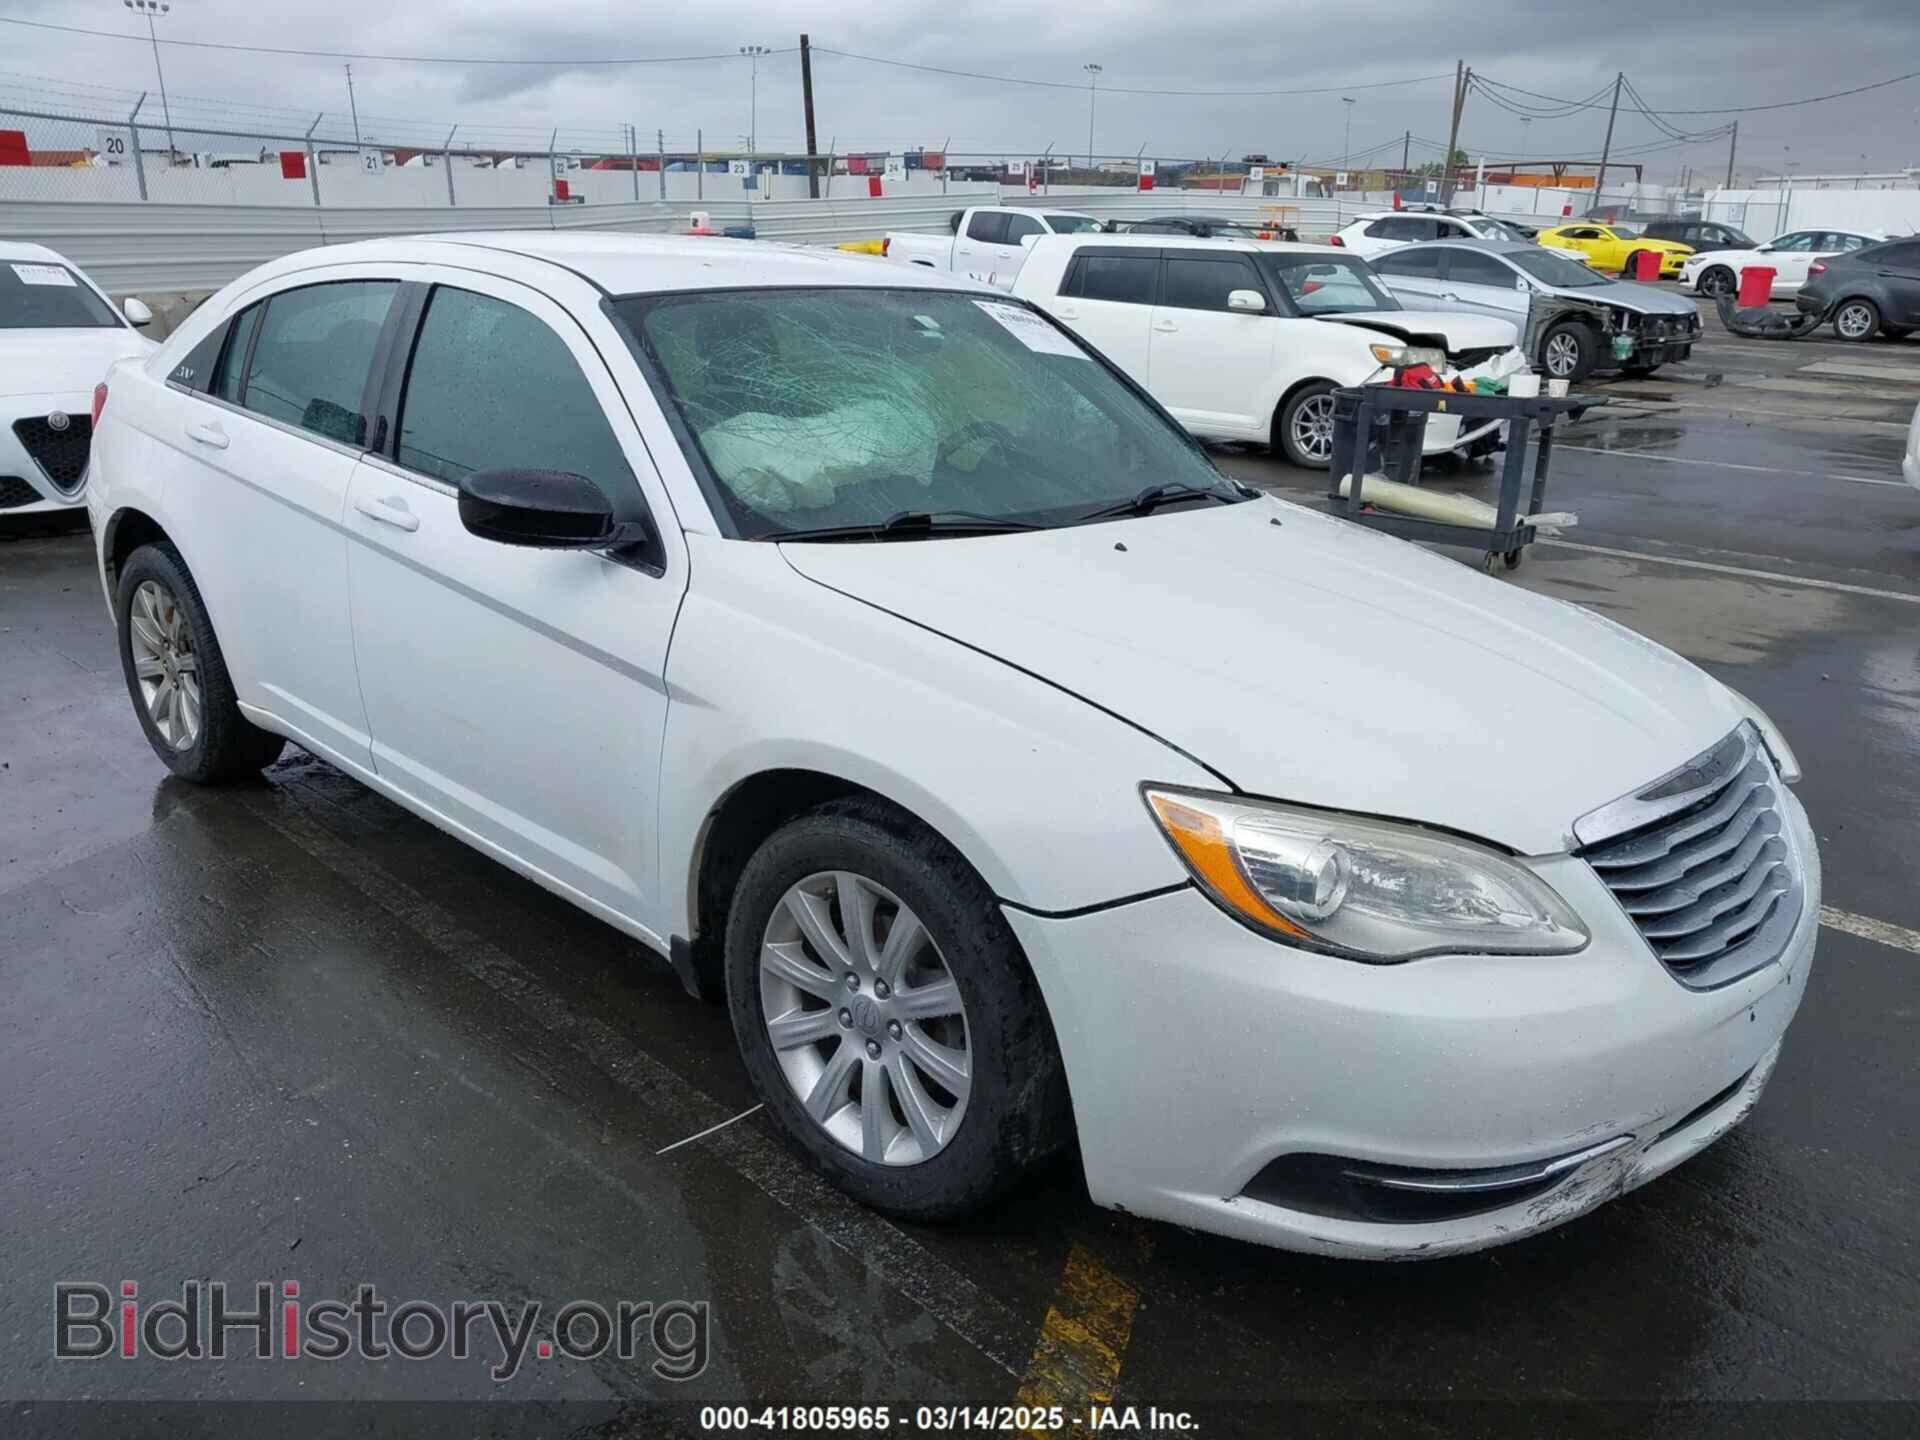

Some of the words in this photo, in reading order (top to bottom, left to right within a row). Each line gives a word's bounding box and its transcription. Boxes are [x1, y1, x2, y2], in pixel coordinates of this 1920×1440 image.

[106, 137, 124, 154] 20
[366, 156, 377, 169] 21
[888, 163, 899, 173] 24
[734, 164, 745, 174] 23
